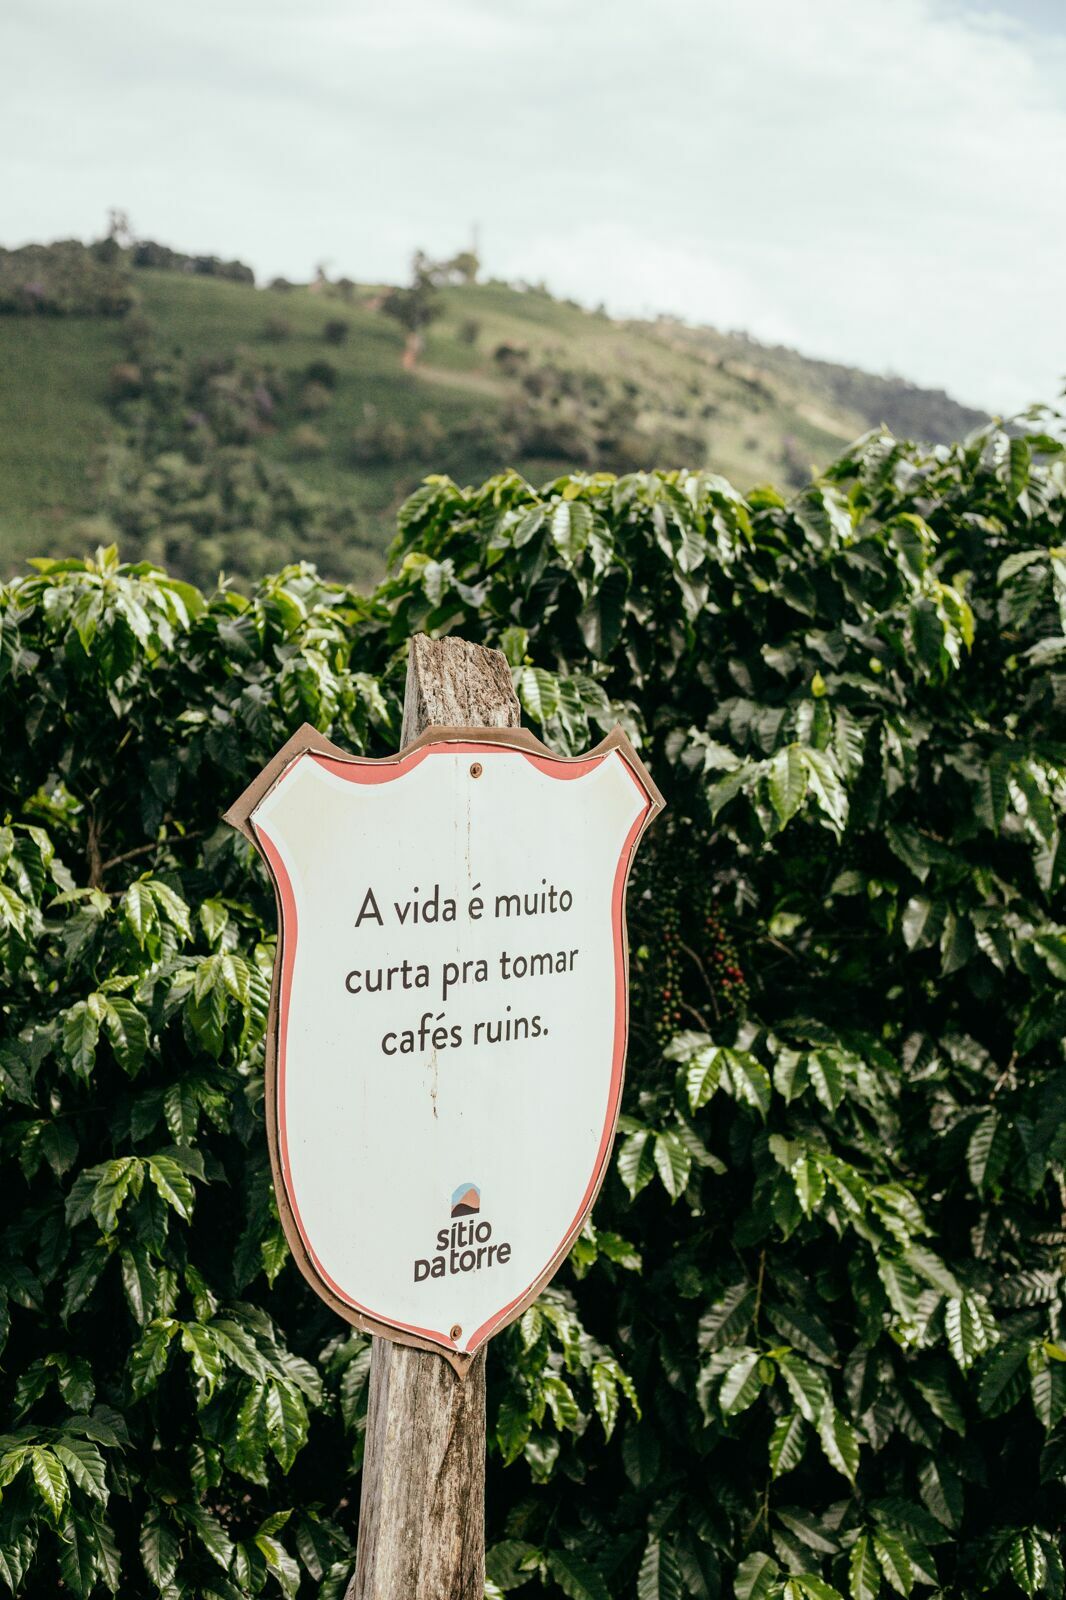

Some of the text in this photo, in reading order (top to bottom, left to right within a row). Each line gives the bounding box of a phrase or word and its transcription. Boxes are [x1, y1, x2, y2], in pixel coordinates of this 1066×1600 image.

[354, 878, 573, 928] A vida é muito
[345, 949, 579, 1002] curta pra tomar
[381, 1005, 549, 1056] cafés ruins.
[436, 1219, 492, 1252] sítio
